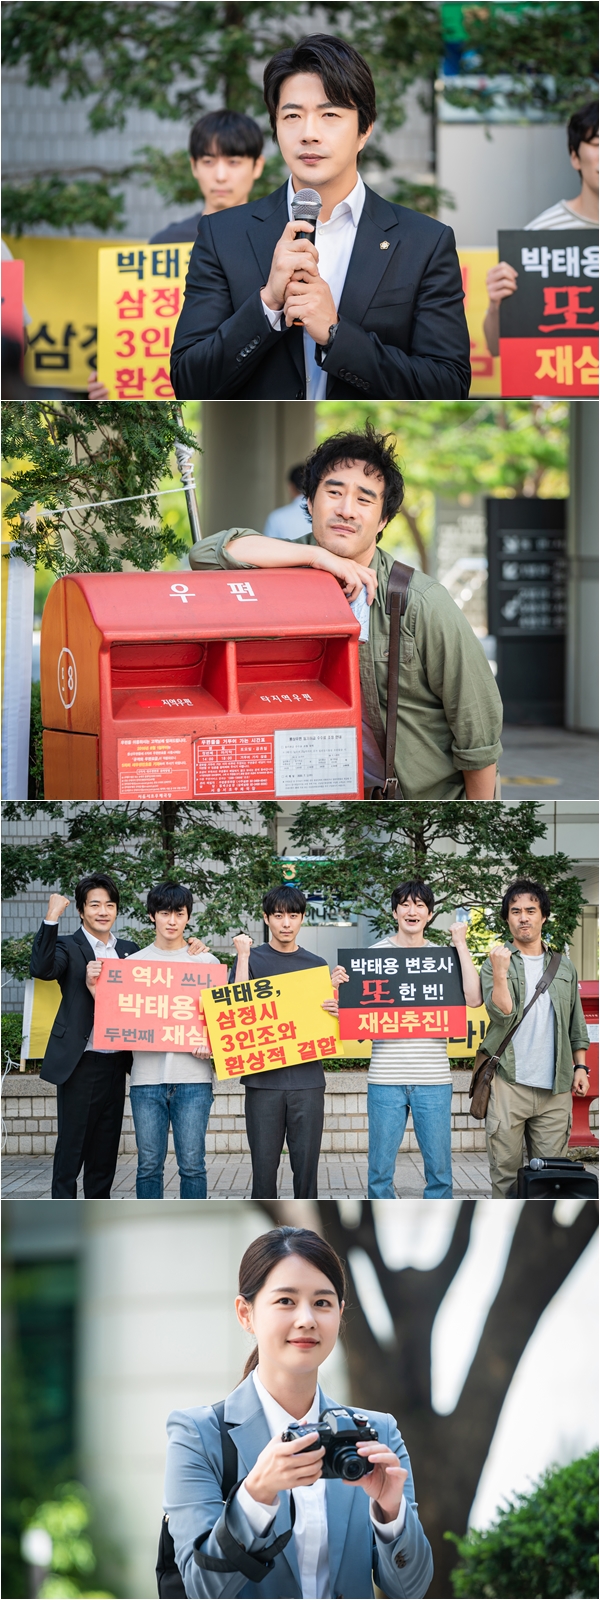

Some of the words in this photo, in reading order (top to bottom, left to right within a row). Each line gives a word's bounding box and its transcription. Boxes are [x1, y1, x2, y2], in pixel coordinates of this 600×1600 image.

[117, 249, 191, 280] 박태
[538, 286, 599, 333] 또
[260, 693, 313, 703] 타지역우편
[106, 969, 123, 984] 또
[132, 966, 174, 988] 역사
[350, 957, 399, 975] 박태용
[405, 956, 454, 974] 변호사
[211, 979, 281, 1006] 박태용,
[359, 979, 395, 1005] 또
[398, 983, 417, 1001] 한
[422, 983, 444, 1001] 번!
[118, 993, 205, 1021] 박태용!
[216, 1000, 279, 1031] 삼정시
[104, 1028, 155, 1043] 두번째
[161, 1025, 207, 1046] 재심
[357, 1010, 449, 1034] 재심추진!
[220, 1020, 297, 1053] 3인조와
[224, 1046, 287, 1077] 환상적
[297, 1035, 337, 1061] 결합
